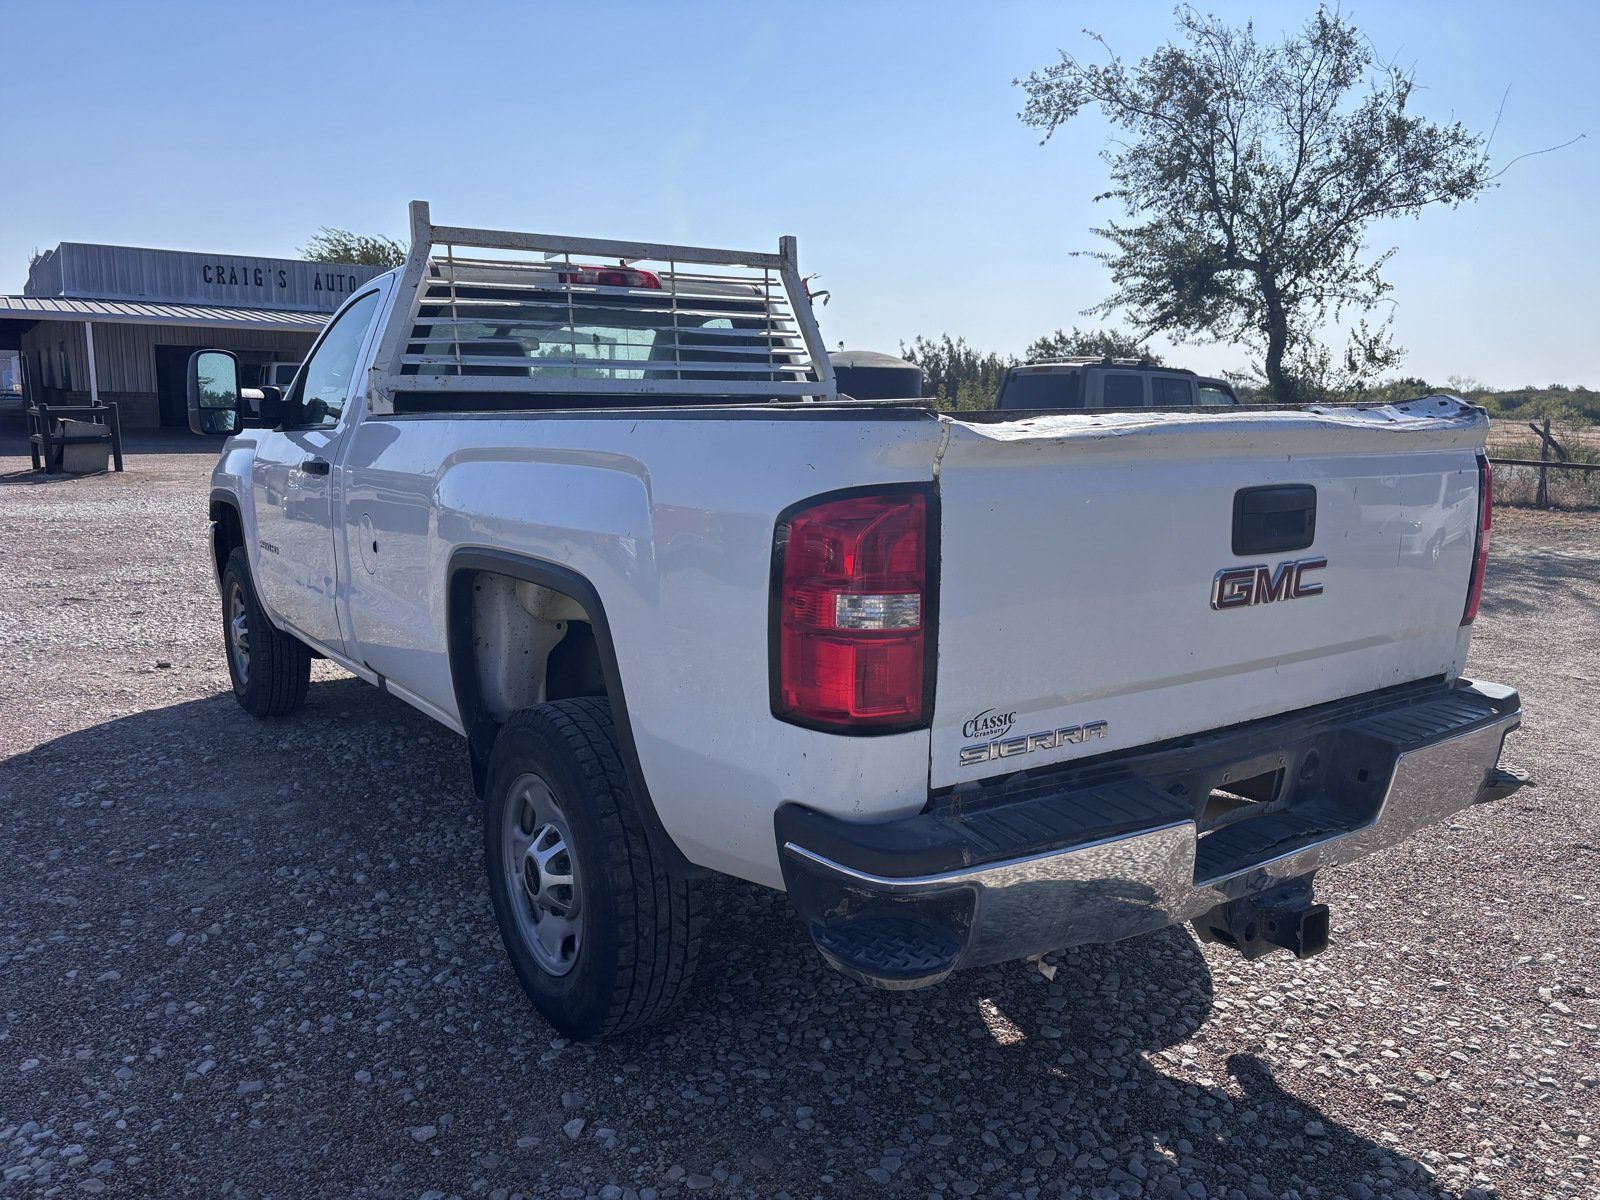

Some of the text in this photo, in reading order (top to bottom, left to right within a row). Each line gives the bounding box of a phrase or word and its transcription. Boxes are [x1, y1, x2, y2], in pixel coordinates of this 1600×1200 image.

[203, 265, 356, 292] CRAIG'S AUTO
[1210, 556, 1328, 610] GMC
[962, 711, 1017, 738] CLASSIC
[974, 728, 1004, 738] Granbury
[960, 720, 1108, 767] SIERRA
